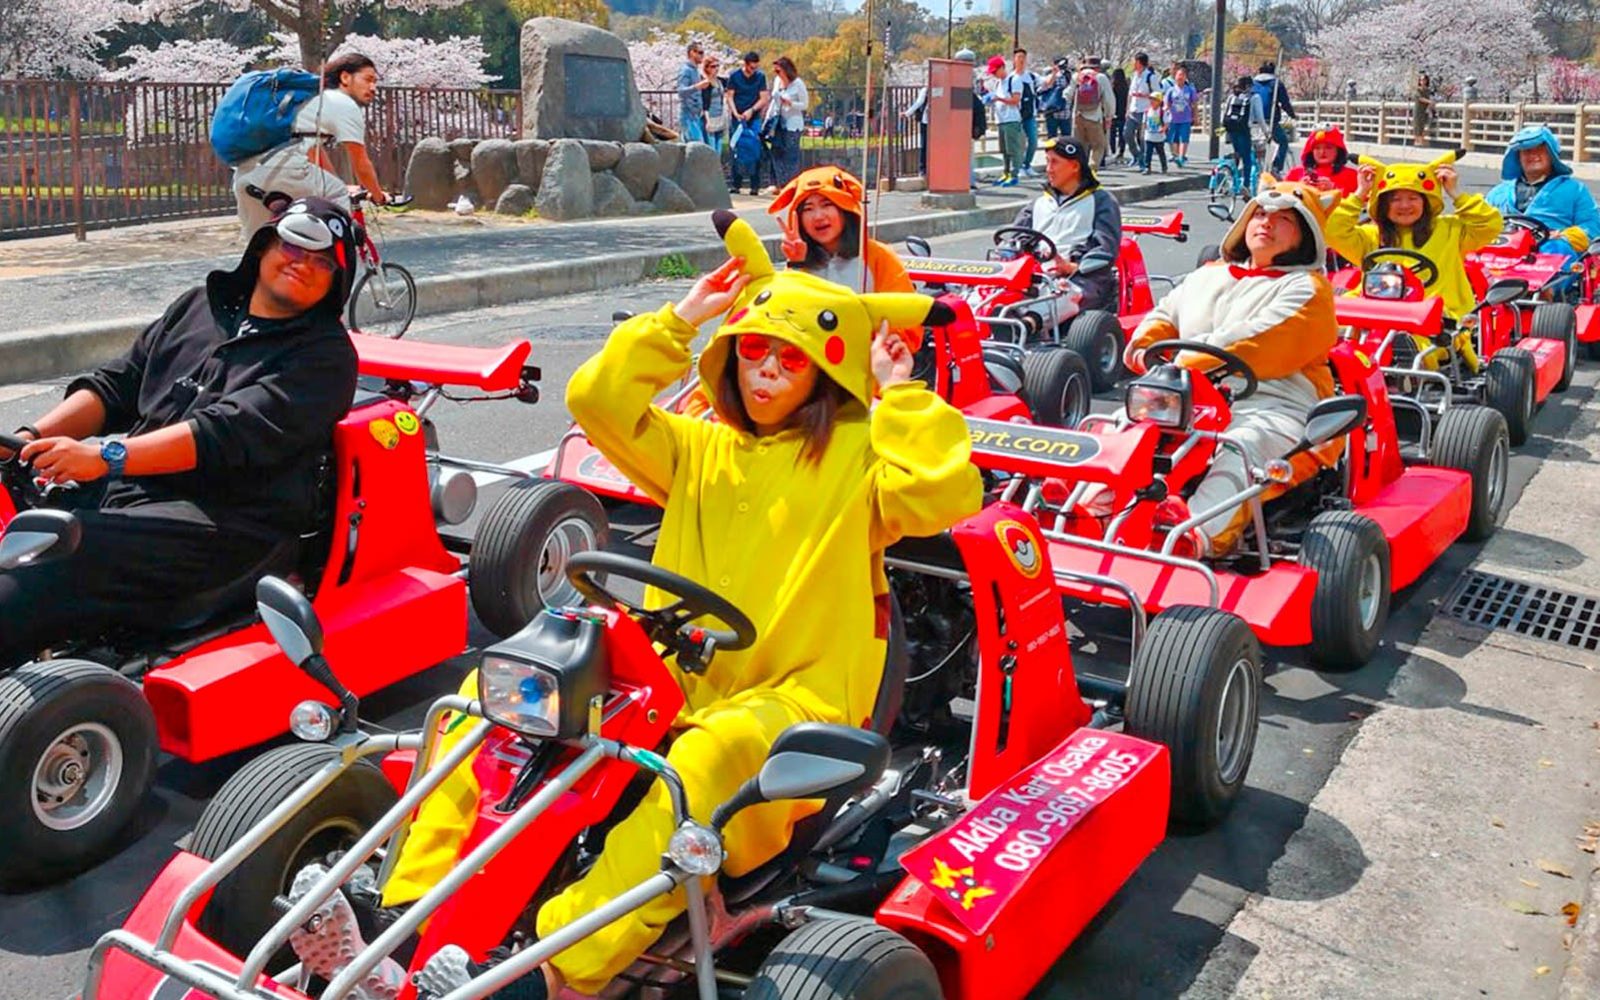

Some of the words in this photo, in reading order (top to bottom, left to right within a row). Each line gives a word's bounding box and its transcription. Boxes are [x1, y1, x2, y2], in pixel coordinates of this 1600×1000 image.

[948, 804, 1020, 862] Akiba
[1001, 772, 1061, 805] Kart
[1042, 736, 1109, 778] Osaka
[994, 749, 1140, 872] 080-9697-8605
